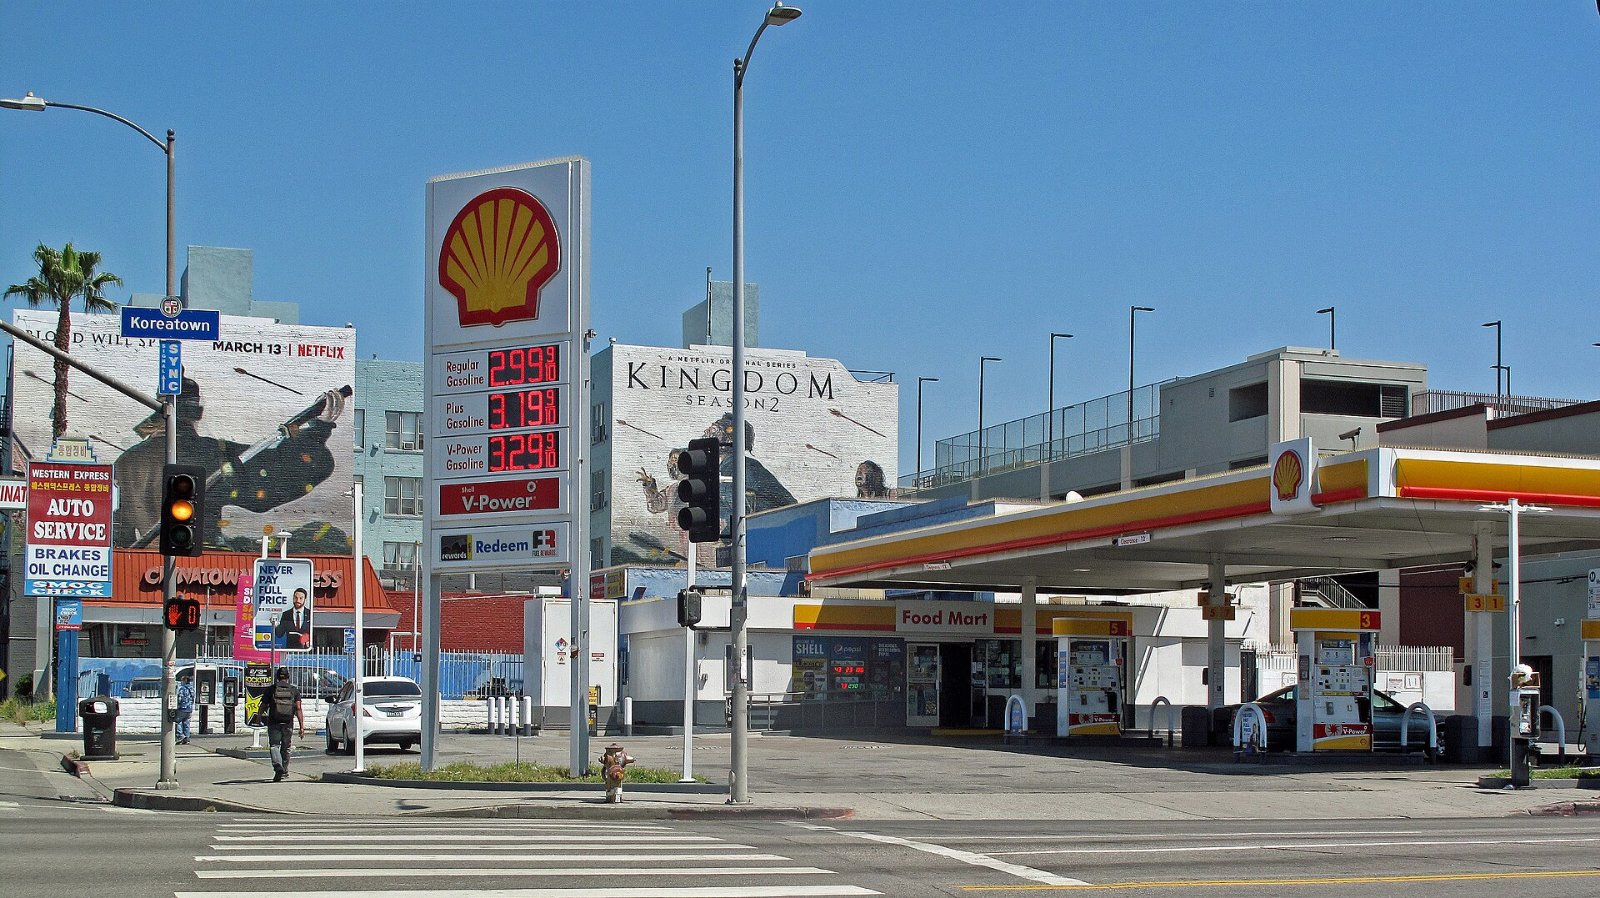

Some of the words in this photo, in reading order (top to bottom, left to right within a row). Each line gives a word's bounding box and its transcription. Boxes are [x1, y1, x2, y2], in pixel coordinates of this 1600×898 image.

[130, 316, 210, 332] Koreatown
[25, 329, 84, 343] BLOD
[92, 333, 133, 346] WILL
[212, 340, 263, 353] MARCH
[267, 344, 282, 355] 13
[297, 344, 344, 359] NETFLIX
[168, 343, 179, 391] SYNC
[447, 359, 480, 374] Regular
[490, 347, 543, 386] 2.99
[447, 374, 484, 388] Gasoline
[627, 362, 834, 399] KINGDOM
[447, 402, 464, 414] Plus
[490, 390, 543, 429] 3.19
[770, 397, 779, 412] 2
[447, 411, 484, 429] Gasoline
[447, 444, 482, 455] V-Power
[490, 434, 543, 471] 3.29
[447, 458, 484, 470] Gasoline
[32, 469, 70, 479] WESTERN
[74, 471, 109, 480] EXPRESS
[47, 499, 94, 517] AUTO
[462, 495, 532, 511] V-Power
[34, 521, 106, 541] SERVICE
[476, 539, 528, 553] Redeem
[35, 548, 101, 561] BRAKES
[442, 551, 467, 560] rewards
[29, 563, 49, 575] OIL
[53, 564, 108, 577] CHANGE
[259, 565, 293, 574] NEVER
[33, 581, 104, 589] SMOG
[259, 576, 278, 584] PAY
[32, 588, 104, 596] CHECK
[259, 586, 282, 594] FULL
[258, 596, 287, 605] PRICE
[1474, 598, 1482, 609] 3
[1493, 598, 1498, 609] 1
[902, 610, 943, 625] Food
[948, 611, 988, 625] Mart
[1210, 608, 1217, 617] 5
[1361, 614, 1371, 627] 3
[1111, 623, 1118, 634] 5
[796, 643, 824, 655] SHELL
